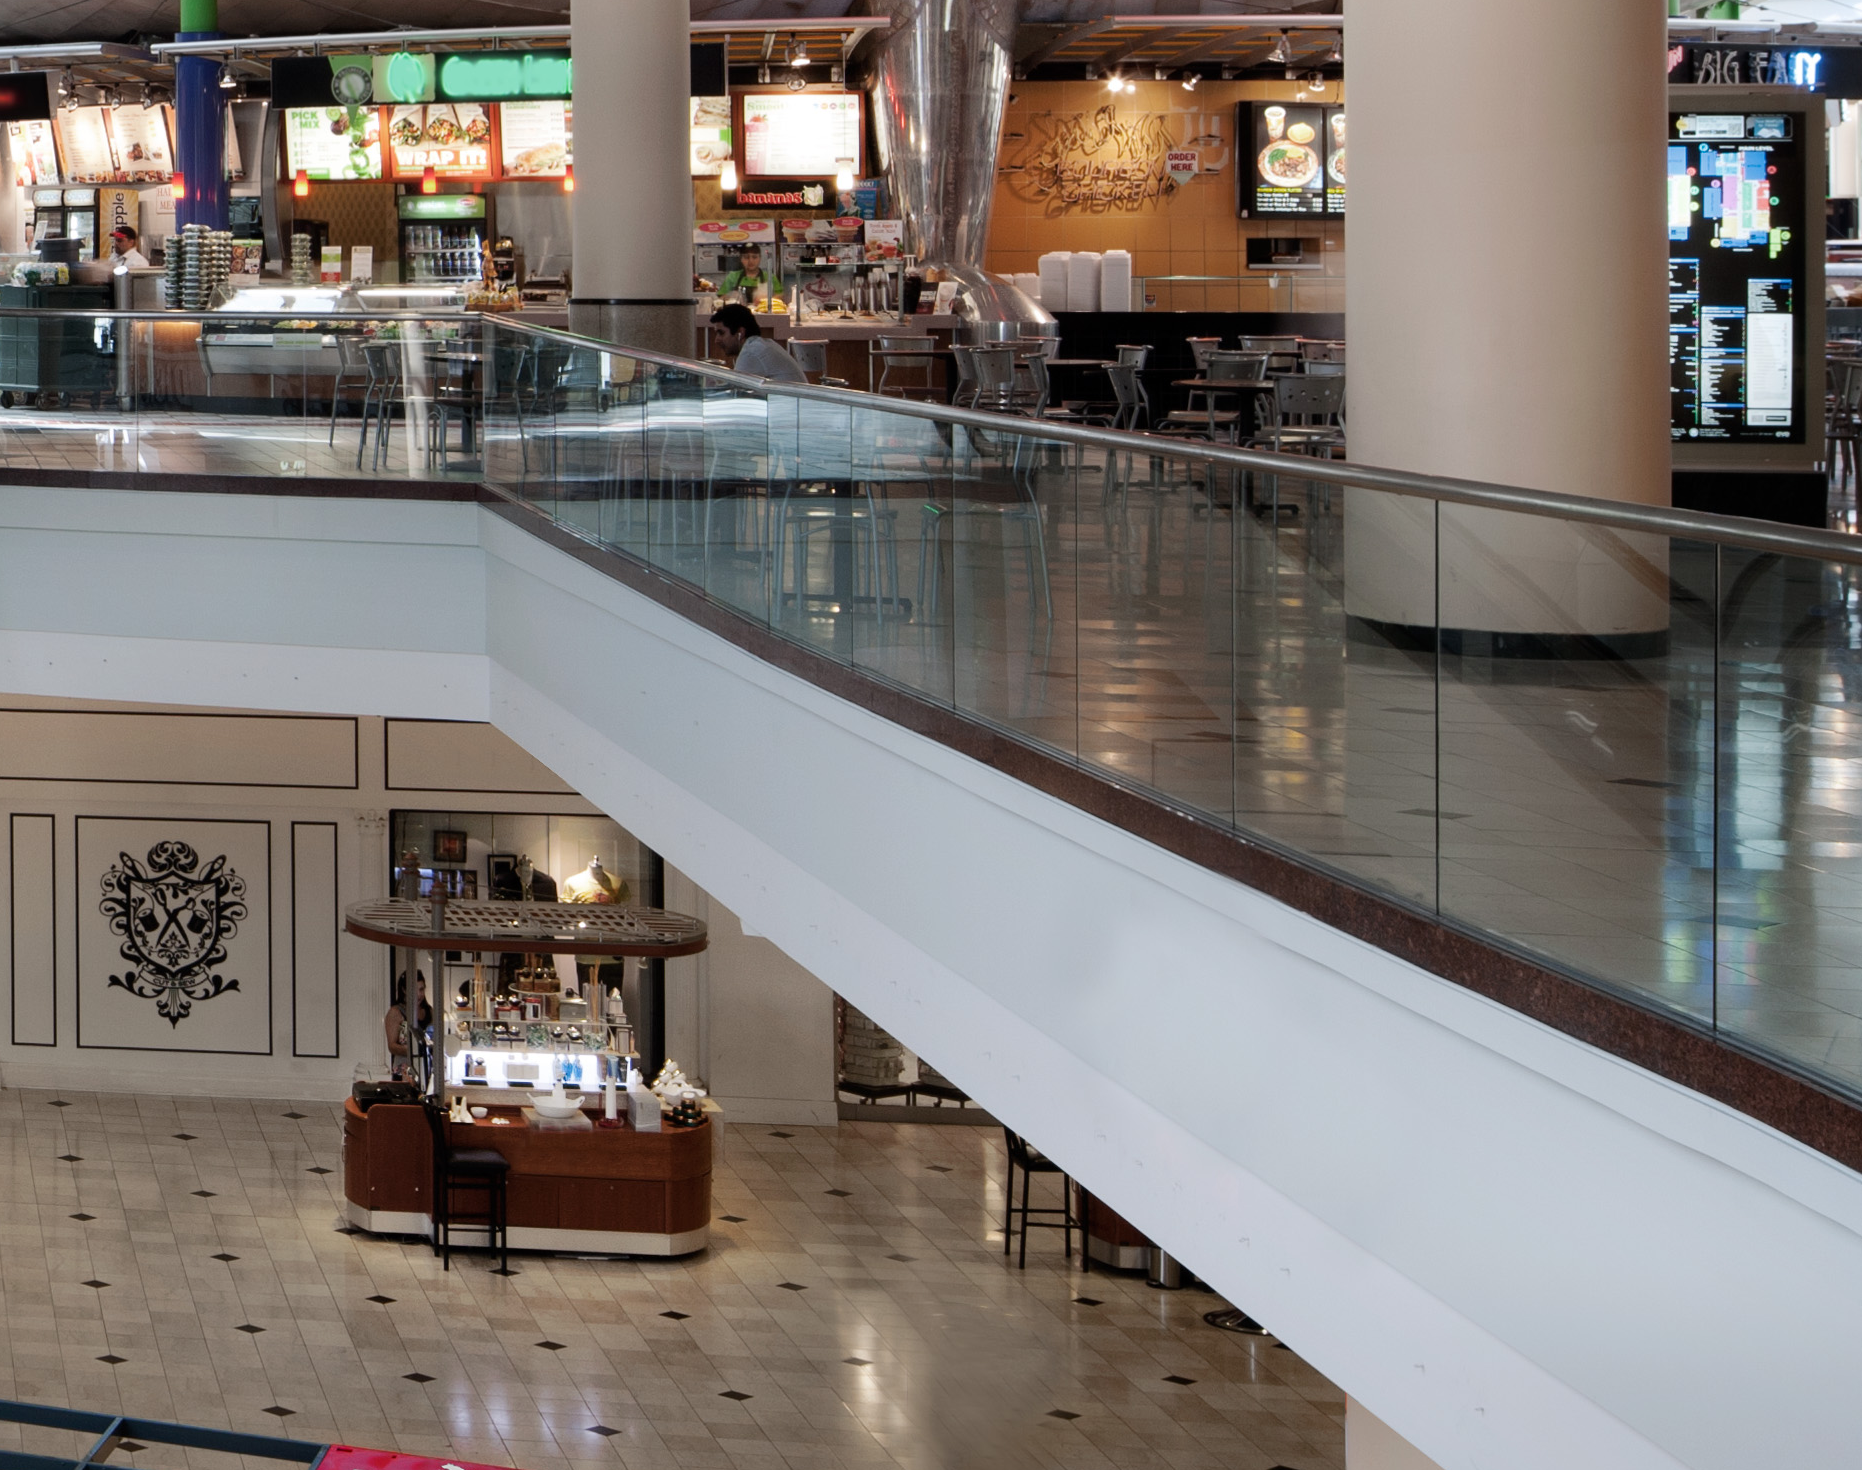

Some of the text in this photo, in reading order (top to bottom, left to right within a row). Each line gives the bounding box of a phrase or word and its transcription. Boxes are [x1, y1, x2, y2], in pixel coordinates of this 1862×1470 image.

[1697, 50, 1740, 85] BIG
[291, 111, 318, 120] PICK
[299, 121, 319, 129] MIX
[396, 150, 454, 165] WRAP
[1168, 152, 1196, 162] ORDER
[1170, 163, 1193, 172] HERE
[736, 185, 803, 205] bananas
[153, 977, 169, 986] CUT
